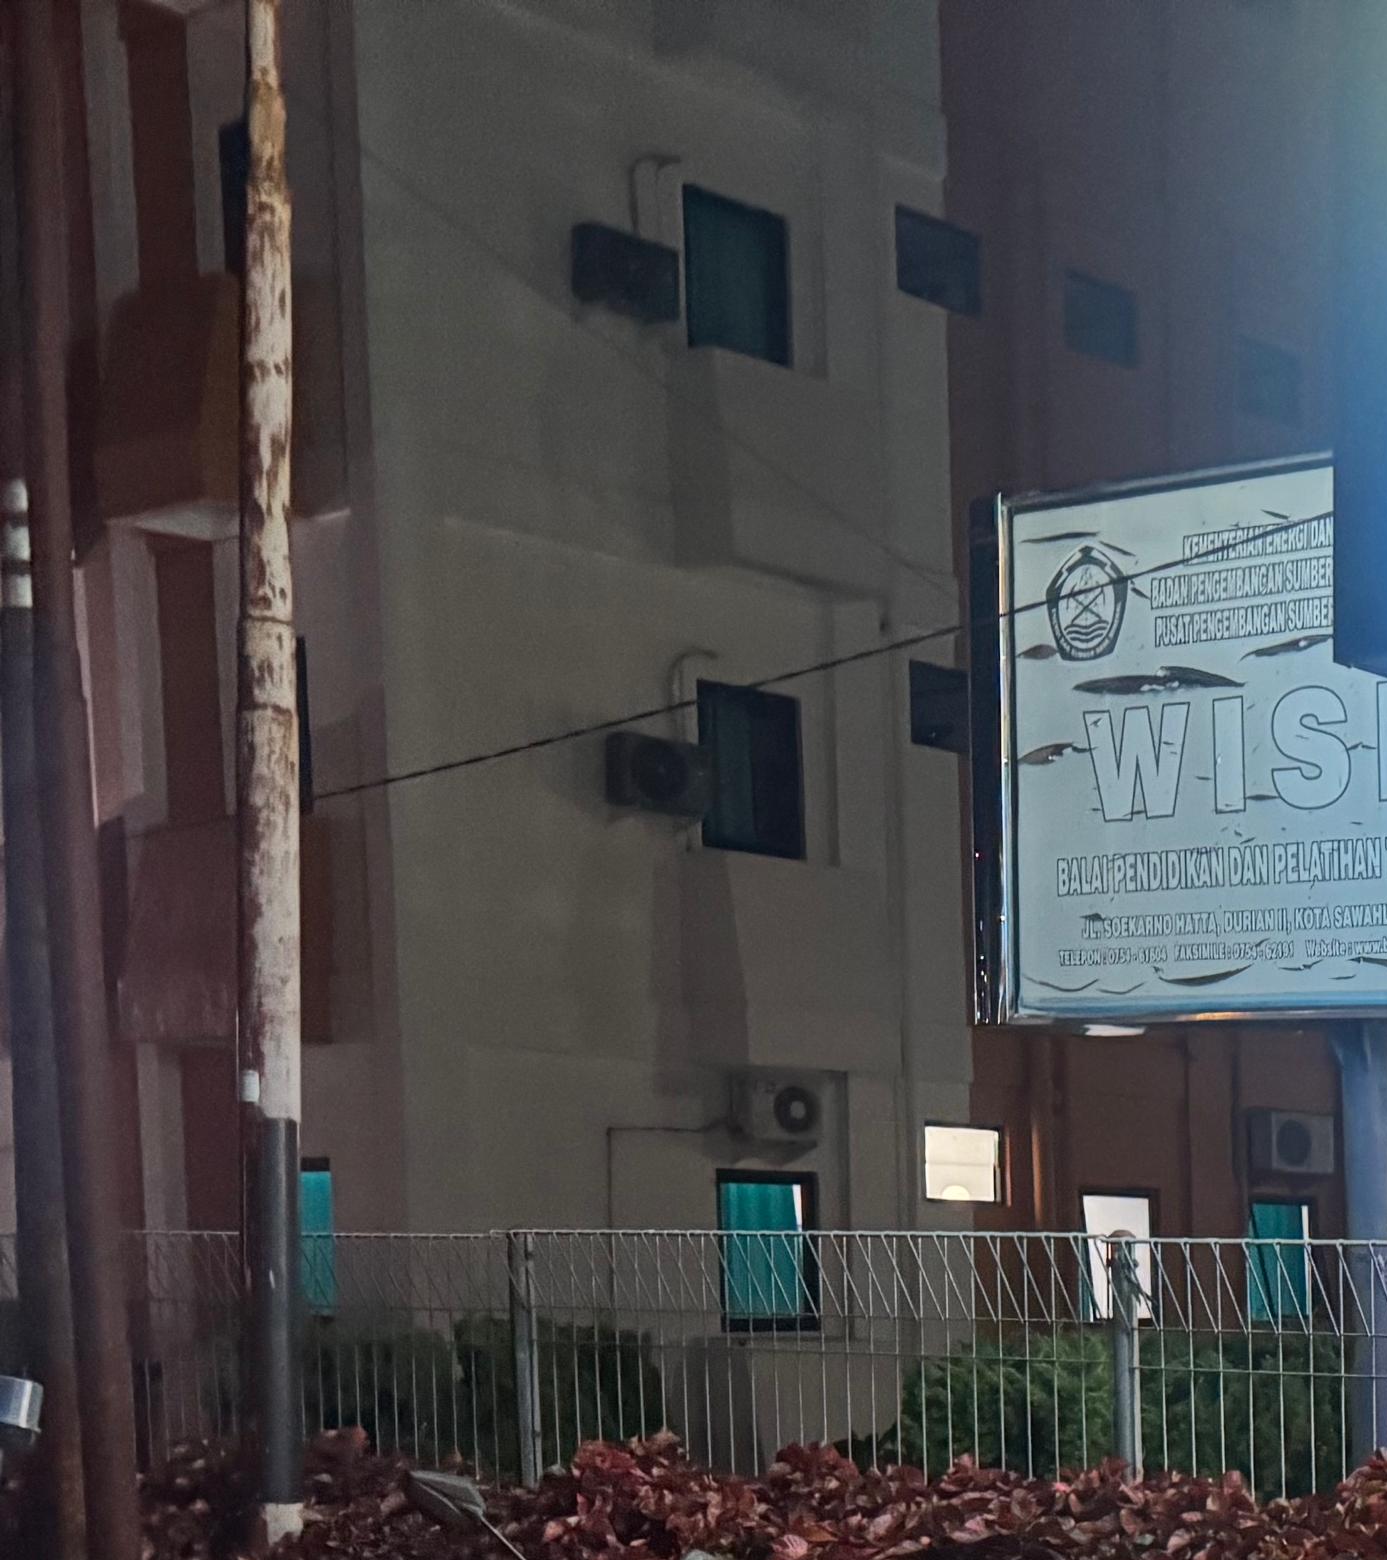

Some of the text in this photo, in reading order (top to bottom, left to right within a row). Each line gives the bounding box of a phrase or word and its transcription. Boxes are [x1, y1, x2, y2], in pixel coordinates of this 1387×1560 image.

[1151, 574, 1189, 610] BADAN
[1190, 561, 1285, 605] PENGEMBANGAN
[1155, 612, 1192, 648] PUSAT
[1192, 600, 1287, 644] PENGEMBANGAN
[1057, 854, 1109, 897] BALAI
[1112, 846, 1226, 894] PENDIDIKAN
[1227, 844, 1269, 888] DAN
[1273, 836, 1382, 883] PELATIHAN
[1103, 914, 1173, 939] SOEKARNO
[1223, 909, 1275, 934] DURIAN
[1294, 906, 1332, 930] KOTA
[1059, 948, 1101, 966] TELEPON
[1174, 942, 1226, 961] FAKSIMILE
